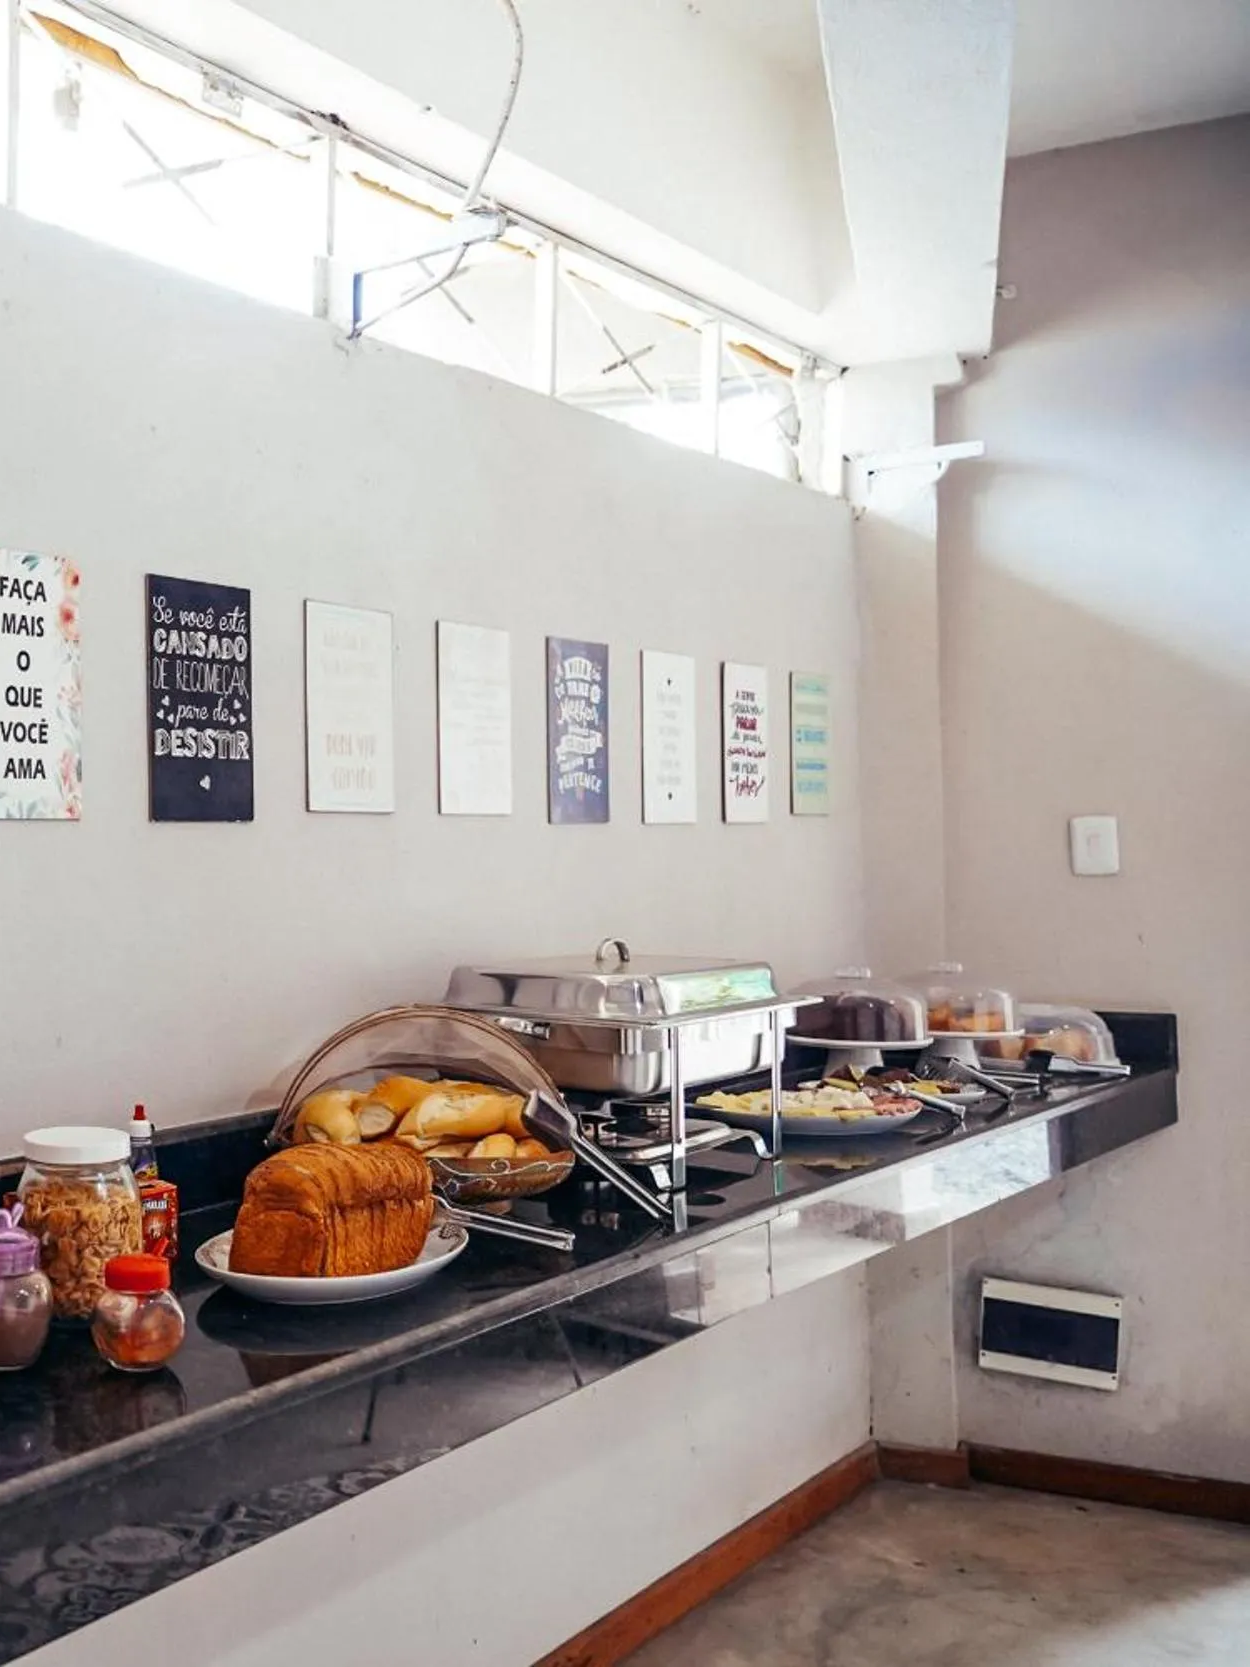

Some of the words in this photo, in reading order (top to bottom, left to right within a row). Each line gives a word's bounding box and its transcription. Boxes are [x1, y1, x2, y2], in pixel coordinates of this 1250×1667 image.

[0, 576, 48, 606] FAÇA
[2, 613, 46, 637] MAIS
[152, 595, 174, 624] Se
[179, 607, 216, 629] você
[152, 628, 248, 662] CANSADO
[16, 651, 31, 672] O
[152, 657, 170, 690] DE
[175, 659, 250, 699] RECOMEÇAR
[5, 685, 43, 709] QUE
[174, 704, 209, 728] pare
[213, 698, 230, 721] de
[0, 718, 49, 744] VOCÊ
[154, 727, 250, 760] DESISTIR
[3, 758, 47, 780] AMA
